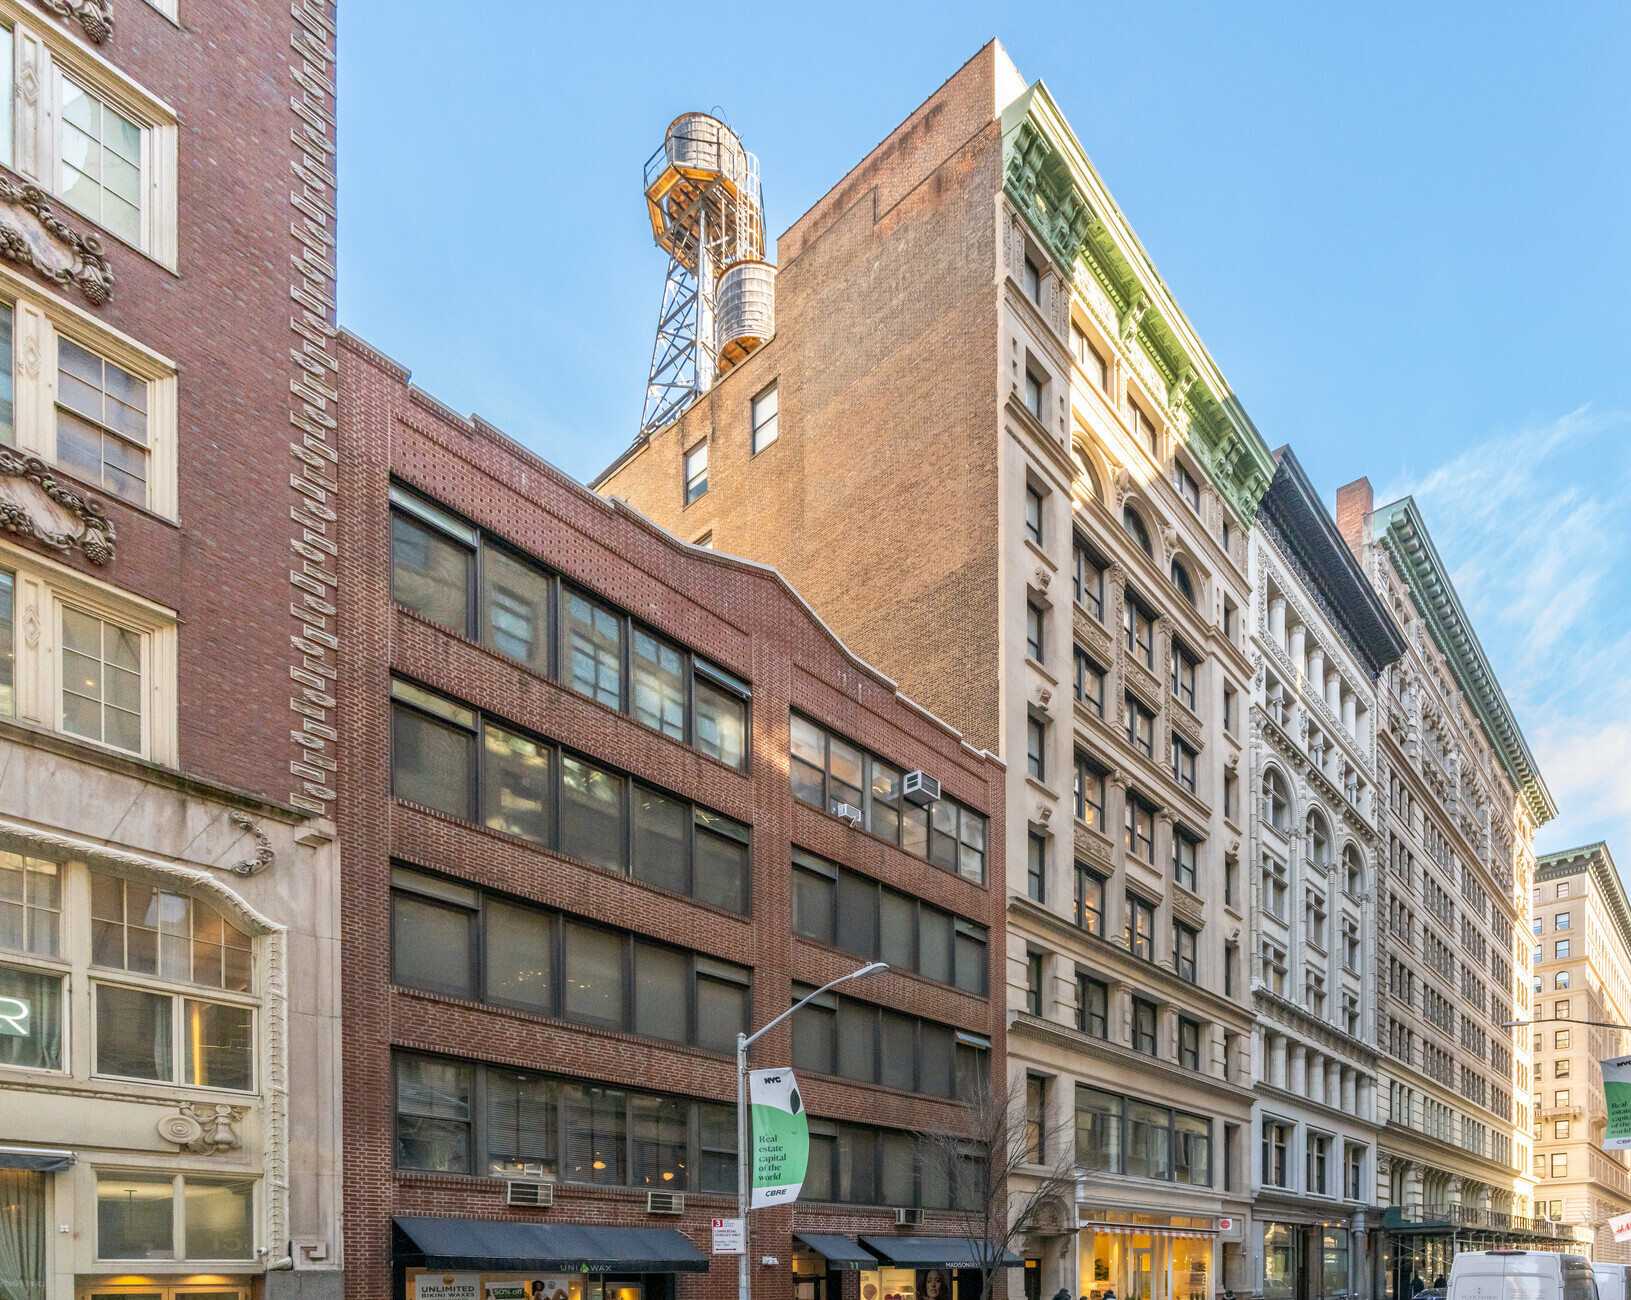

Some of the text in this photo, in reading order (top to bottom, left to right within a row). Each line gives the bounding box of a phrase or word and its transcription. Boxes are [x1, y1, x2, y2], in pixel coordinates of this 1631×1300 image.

[759, 1134, 778, 1143] Real
[759, 1153, 787, 1163] capital
[759, 1163, 782, 1172] of the
[759, 1172, 782, 1181] world
[765, 1188, 787, 1197] CBRE
